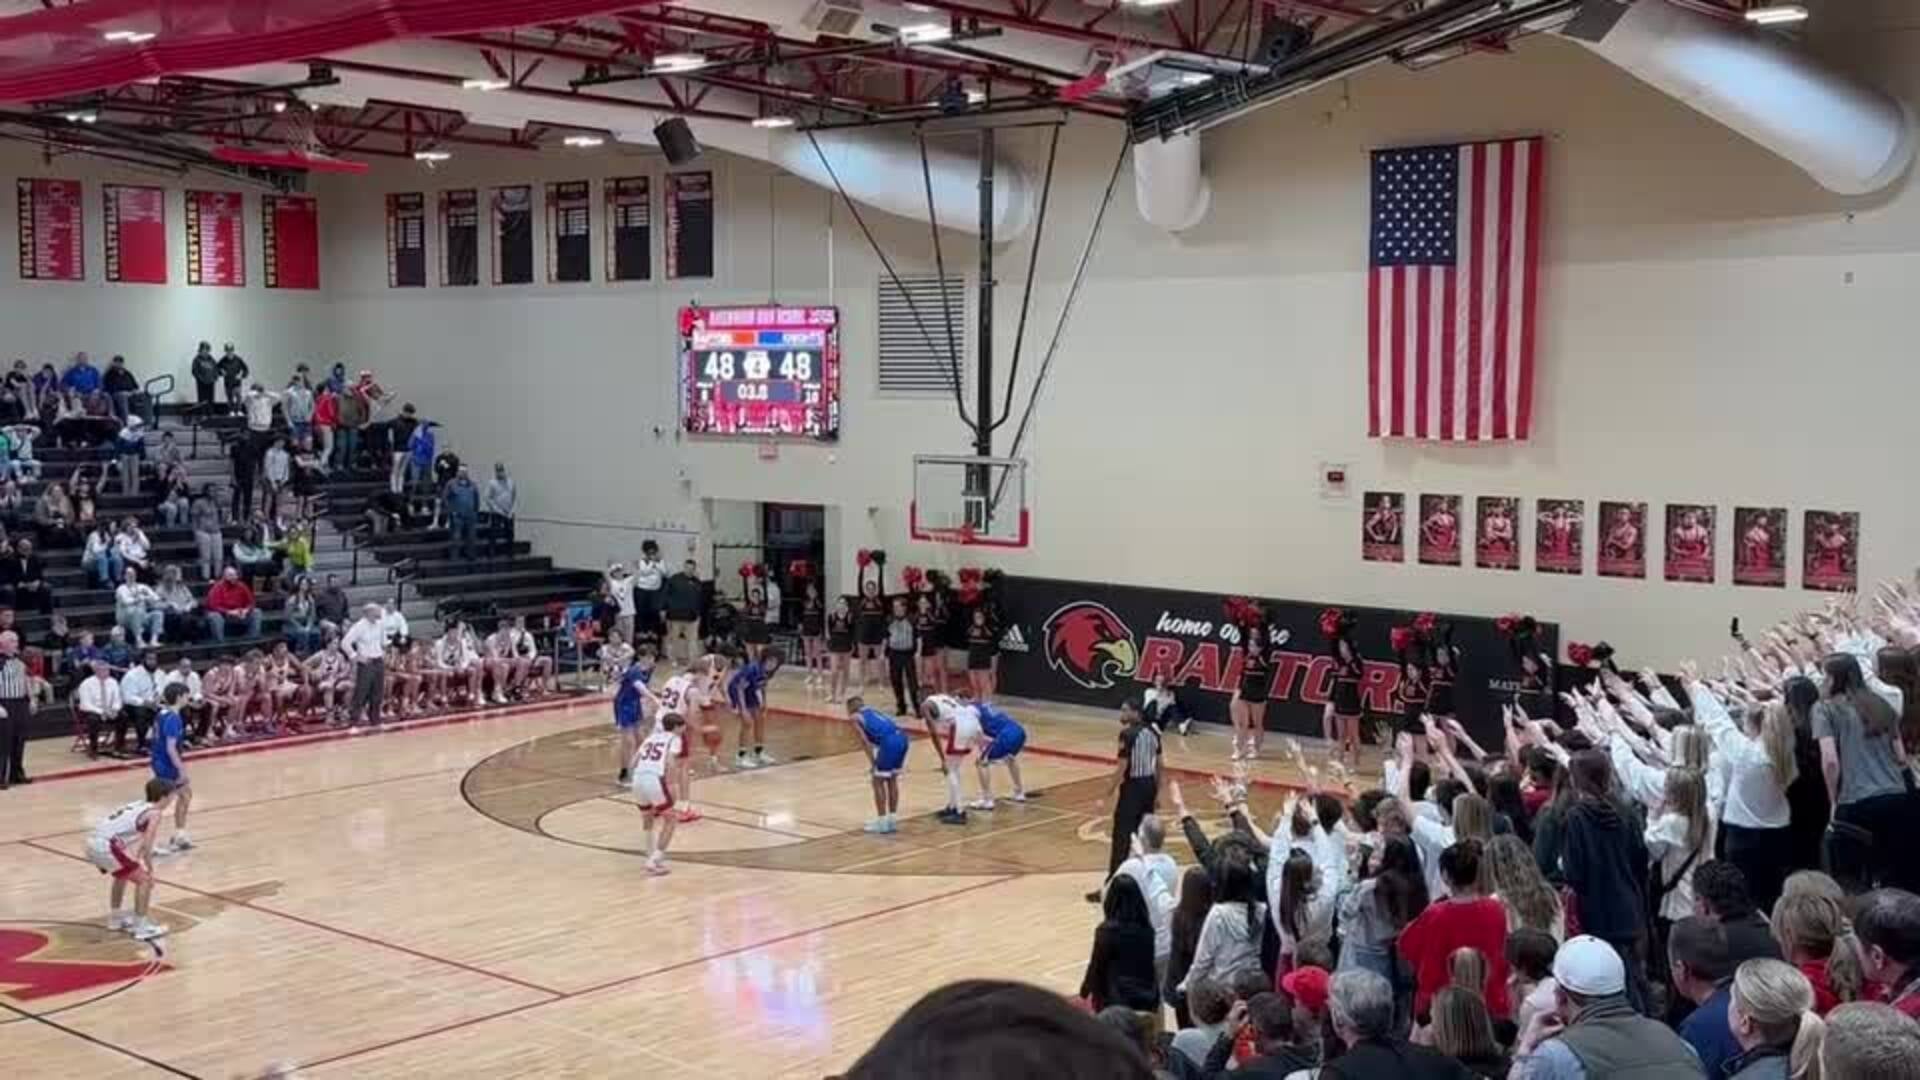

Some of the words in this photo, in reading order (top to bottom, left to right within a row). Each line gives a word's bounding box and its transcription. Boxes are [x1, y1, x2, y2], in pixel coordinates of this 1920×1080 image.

[704, 351, 735, 380] 48
[779, 351, 811, 380] 48
[1156, 611, 1213, 637] home
[662, 687, 680, 709] 23
[641, 742, 665, 761] 35
